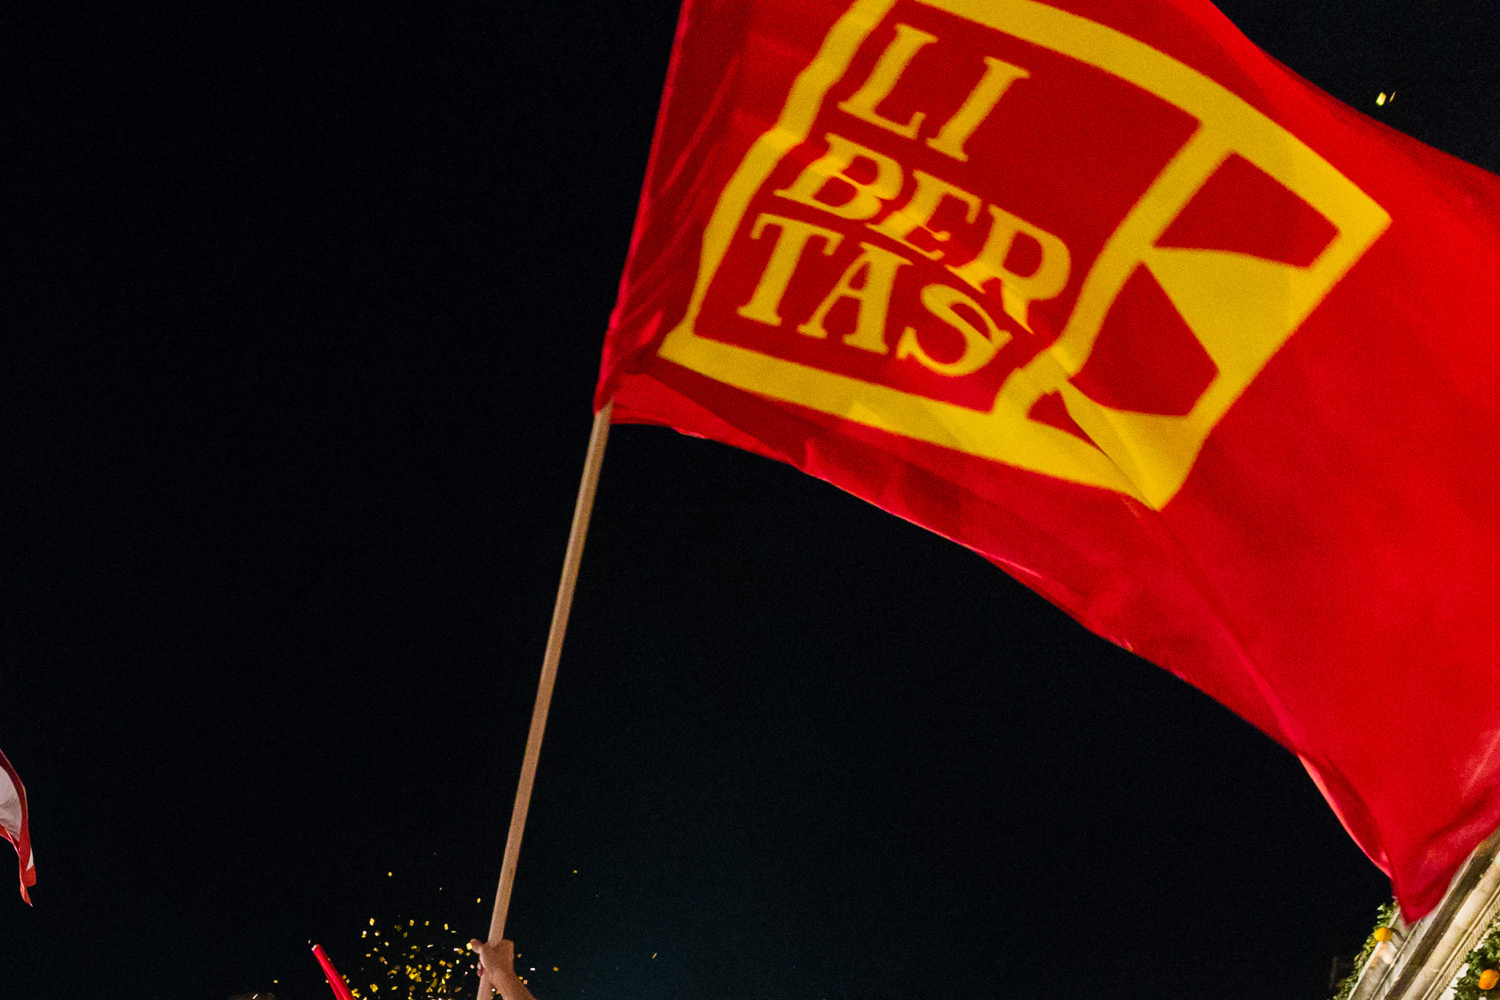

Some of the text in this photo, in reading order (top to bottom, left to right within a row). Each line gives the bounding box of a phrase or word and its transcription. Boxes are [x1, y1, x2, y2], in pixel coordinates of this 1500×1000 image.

[838, 23, 1032, 162] LI
[736, 212, 1013, 378] TAS
[774, 132, 1072, 335] BER
